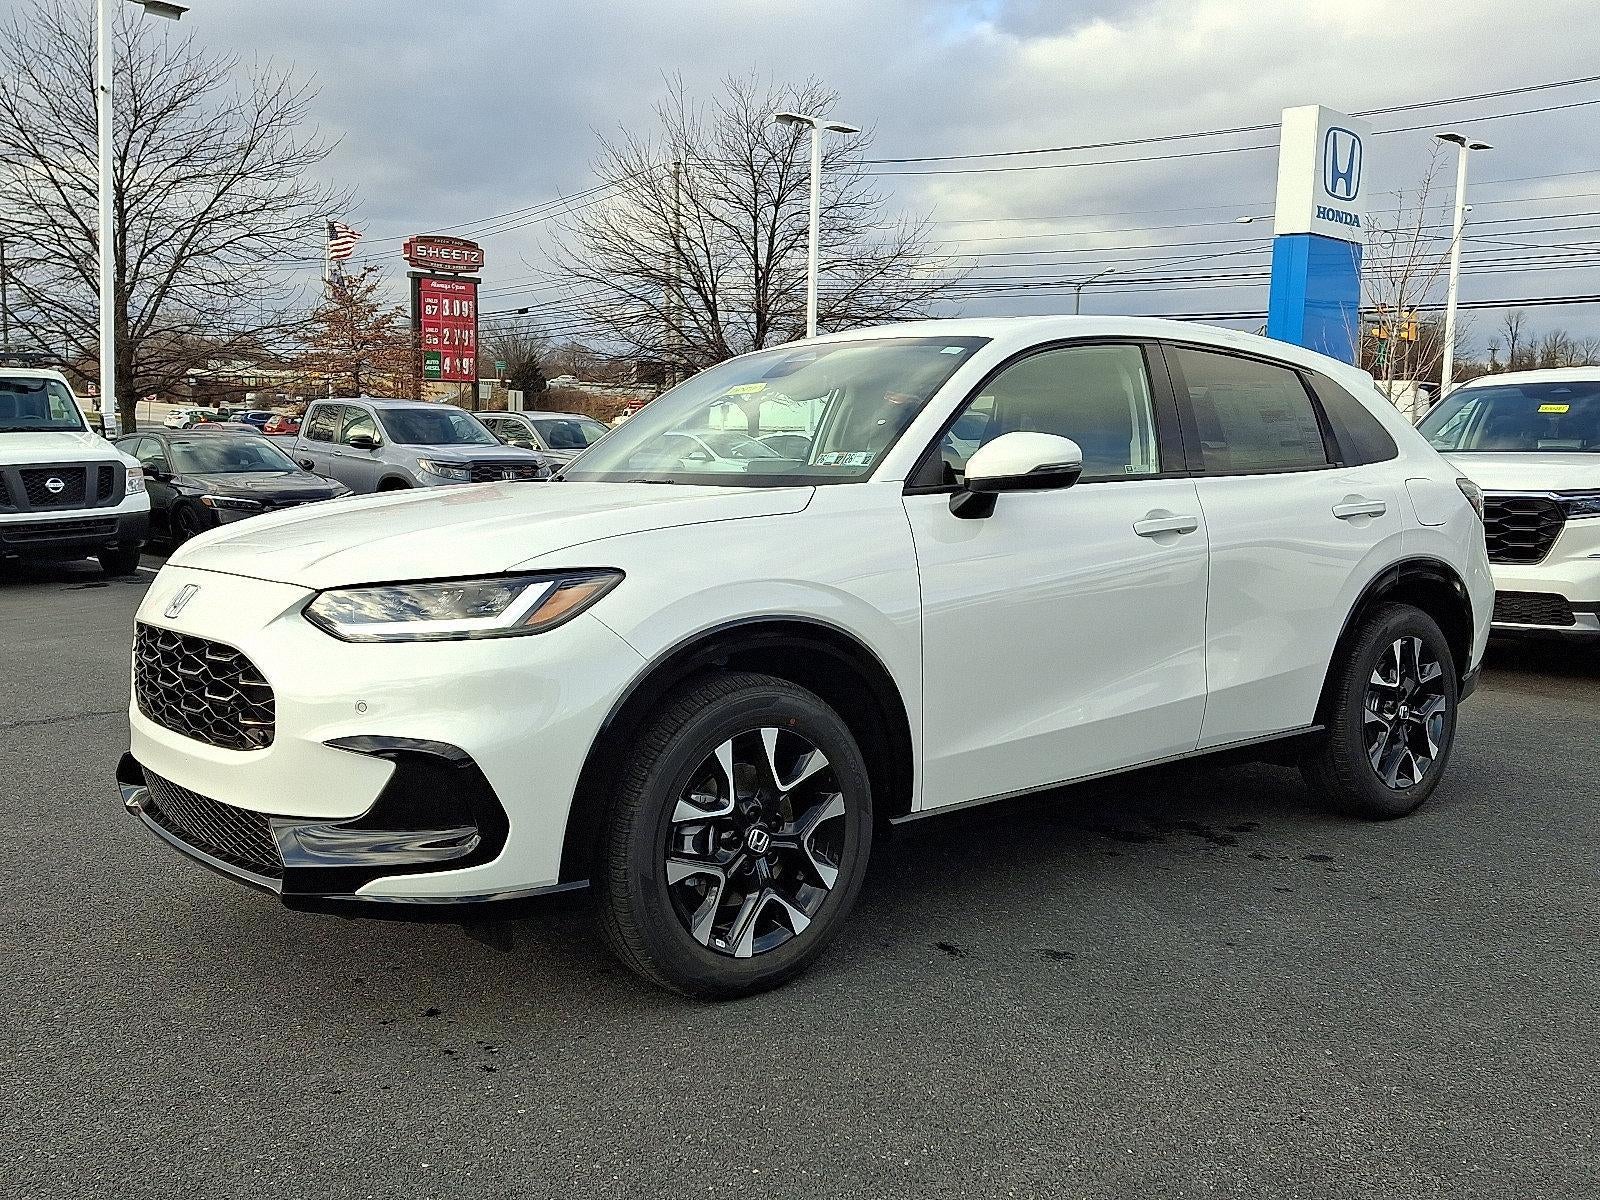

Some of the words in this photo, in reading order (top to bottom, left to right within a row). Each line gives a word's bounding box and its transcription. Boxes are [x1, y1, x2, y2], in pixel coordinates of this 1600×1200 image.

[1316, 205, 1361, 227] HONDA
[416, 246, 480, 262] SHEETZ
[451, 283, 466, 291] Open
[425, 304, 438, 315] 87
[442, 298, 468, 317] 3.09
